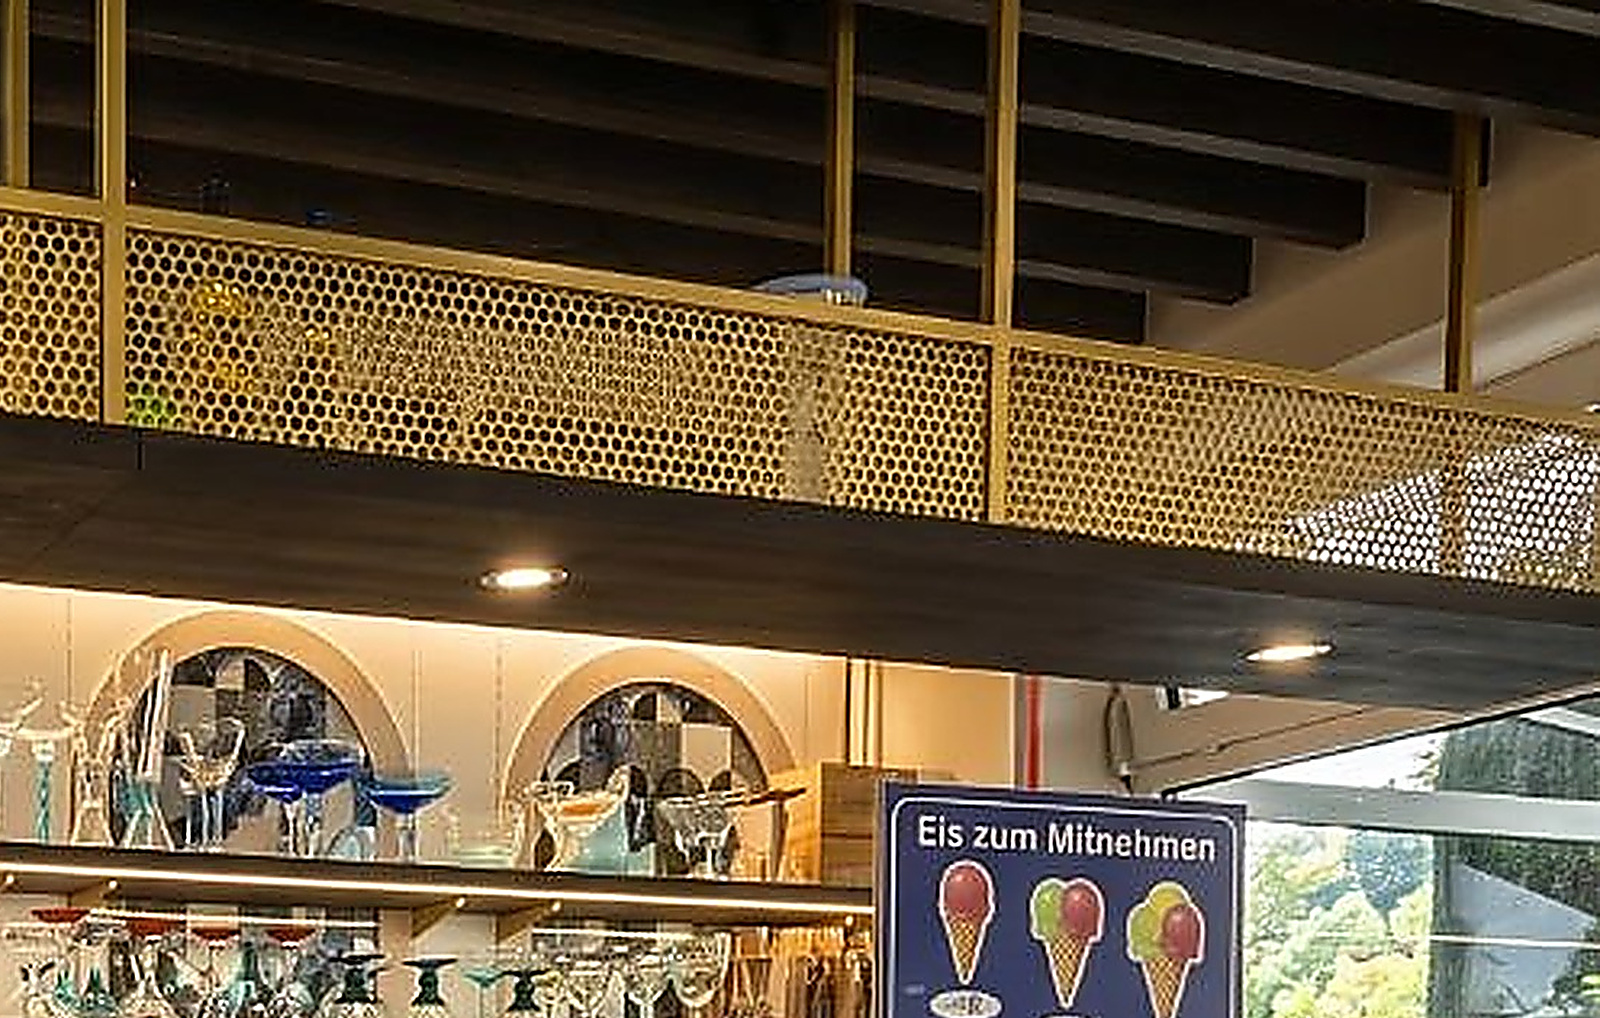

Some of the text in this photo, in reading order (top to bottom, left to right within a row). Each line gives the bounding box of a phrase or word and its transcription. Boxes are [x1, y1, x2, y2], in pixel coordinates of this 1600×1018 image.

[918, 815, 1216, 862] Eis zum Mitnehmen
